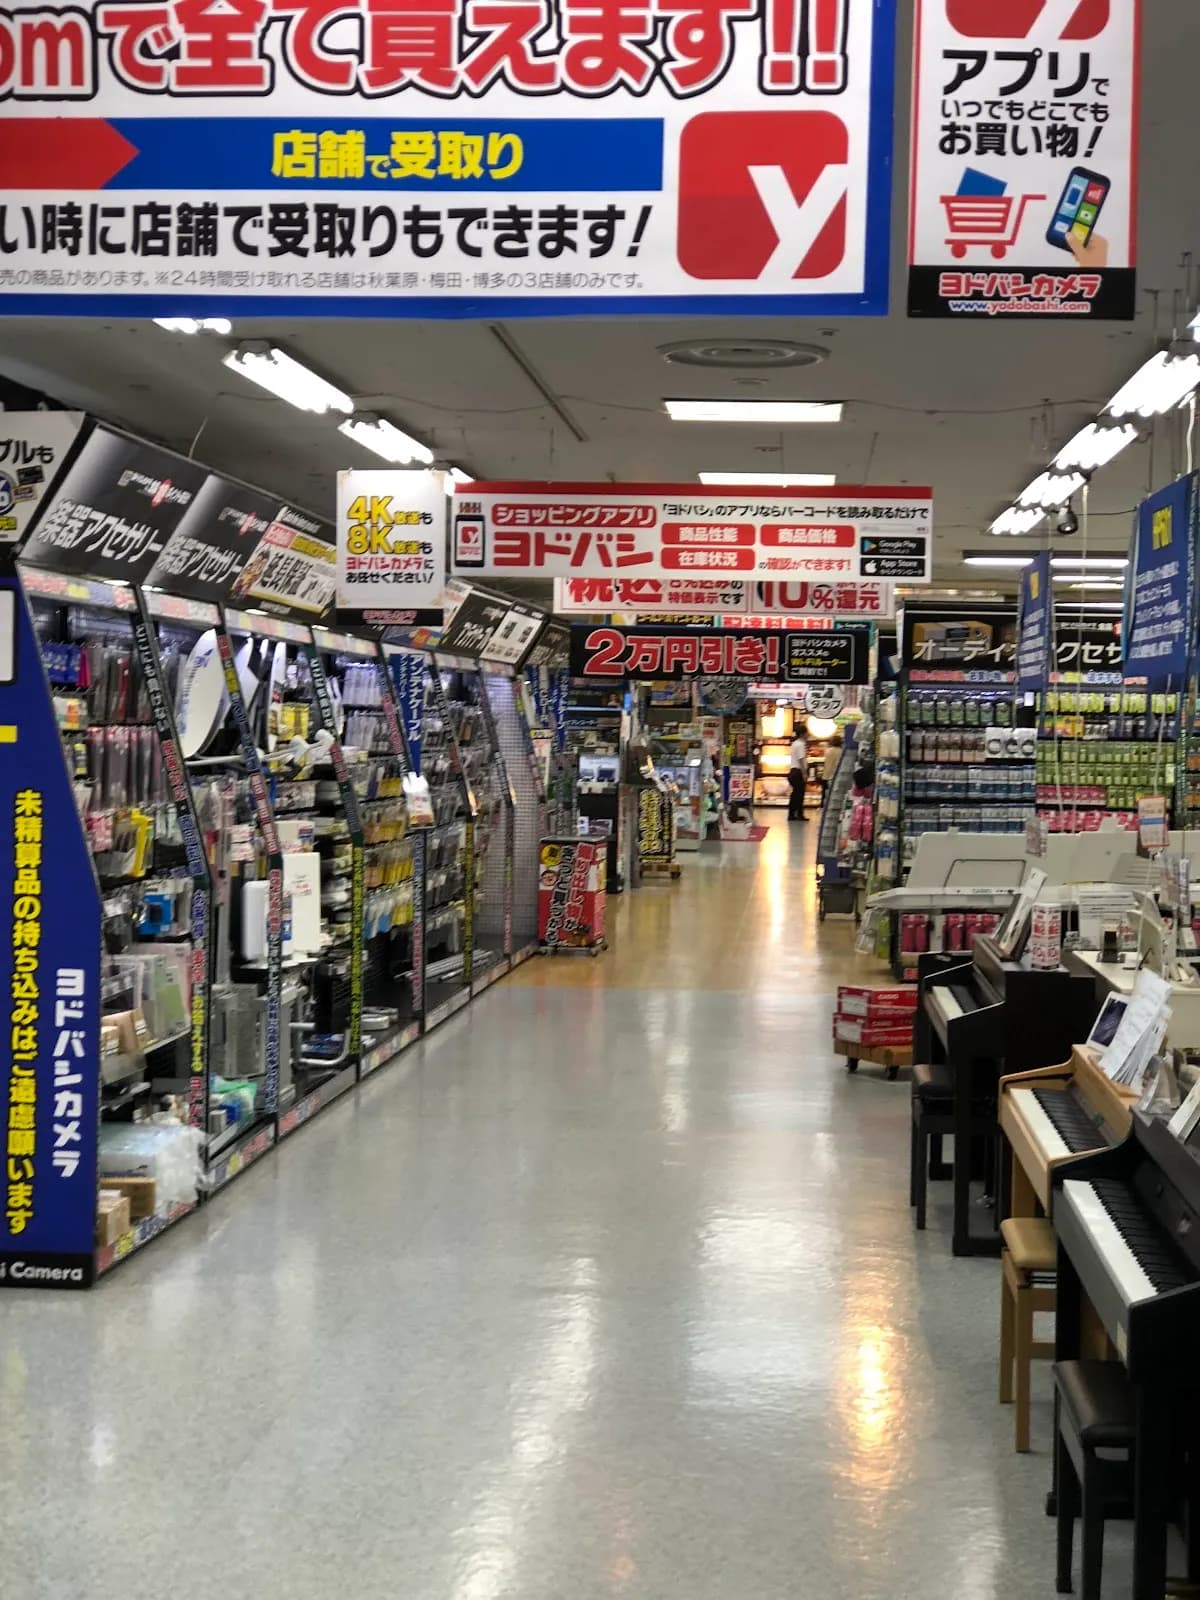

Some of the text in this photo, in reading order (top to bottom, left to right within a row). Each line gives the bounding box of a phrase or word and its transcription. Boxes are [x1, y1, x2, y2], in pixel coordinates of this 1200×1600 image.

[942, 47, 1110, 97] アプリで
[941, 99, 1109, 122] いつでもどこでも
[938, 121, 1103, 157] お買い物!
[271, 130, 523, 180] 店舗で受取り
[0, 201, 652, 258] い時に店舗で受取りもできます!
[939, 272, 1102, 298] ヨドバシカメラ
[948, 298, 1091, 315] www.yodobashi.com
[496, 505, 654, 525] ショッピングアプリ
[39, 498, 163, 564] 楽器アクセサリー
[678, 526, 739, 543] 商品性能
[777, 528, 838, 545] 商品価格
[493, 531, 654, 568] ヨドバシ
[677, 550, 739, 568] 在庫状況
[346, 557, 435, 570] ヨドバシカメラに
[583, 628, 780, 676] 2万円引き!
[52, 967, 85, 1178] ヨドバシカメラ
[10, 1262, 84, 1281] Camera
